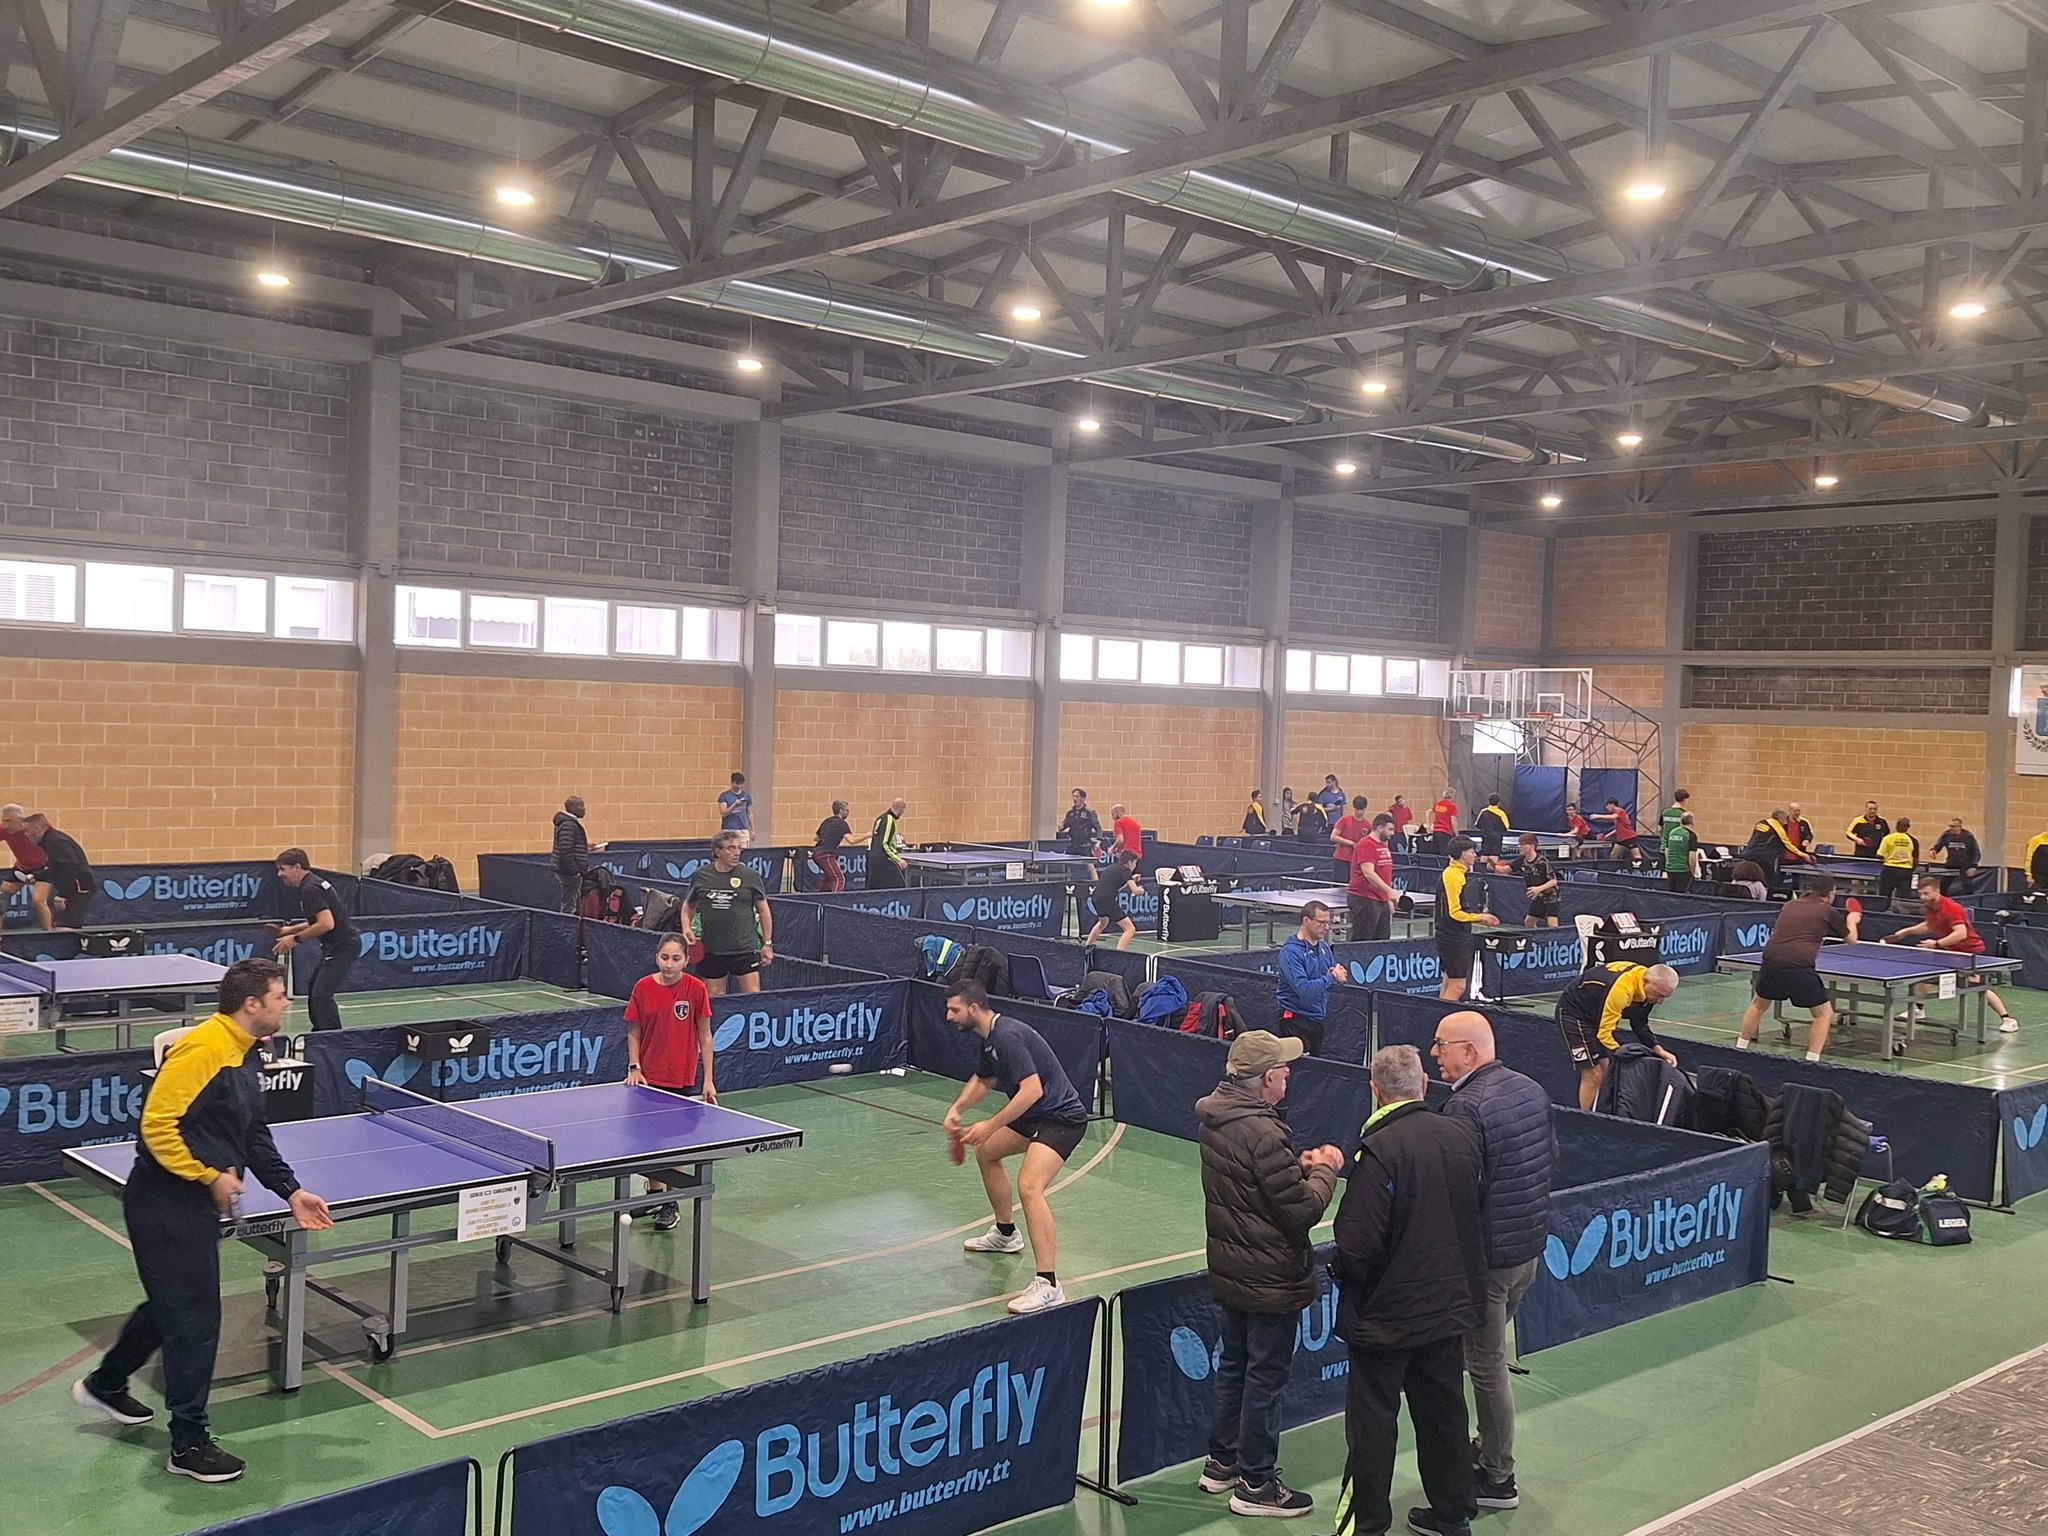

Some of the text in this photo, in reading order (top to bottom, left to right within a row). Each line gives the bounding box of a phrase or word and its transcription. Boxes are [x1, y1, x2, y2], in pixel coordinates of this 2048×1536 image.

[154, 873, 262, 900] Butterfly
[977, 894, 1053, 921] Butterfly
[1115, 891, 1159, 915] Butte
[1161, 904, 1170, 941] Butterfly
[379, 926, 502, 961] Butterfly
[1526, 938, 1583, 969] Butterf
[1659, 927, 1709, 955] utterfly
[1385, 952, 1444, 983] Butter
[749, 1002, 883, 1050] Butterfly
[784, 1046, 864, 1064] www.butterfly.tt
[760, 1139, 794, 1152] Butterfly
[236, 1221, 286, 1237] Butterfly
[1609, 1182, 1743, 1269] Butterfly
[1644, 1249, 1726, 1286] www.butterfly.tt
[755, 1361, 1046, 1518] Butterfly
[839, 1458, 1011, 1535] www.butterfly.tt
